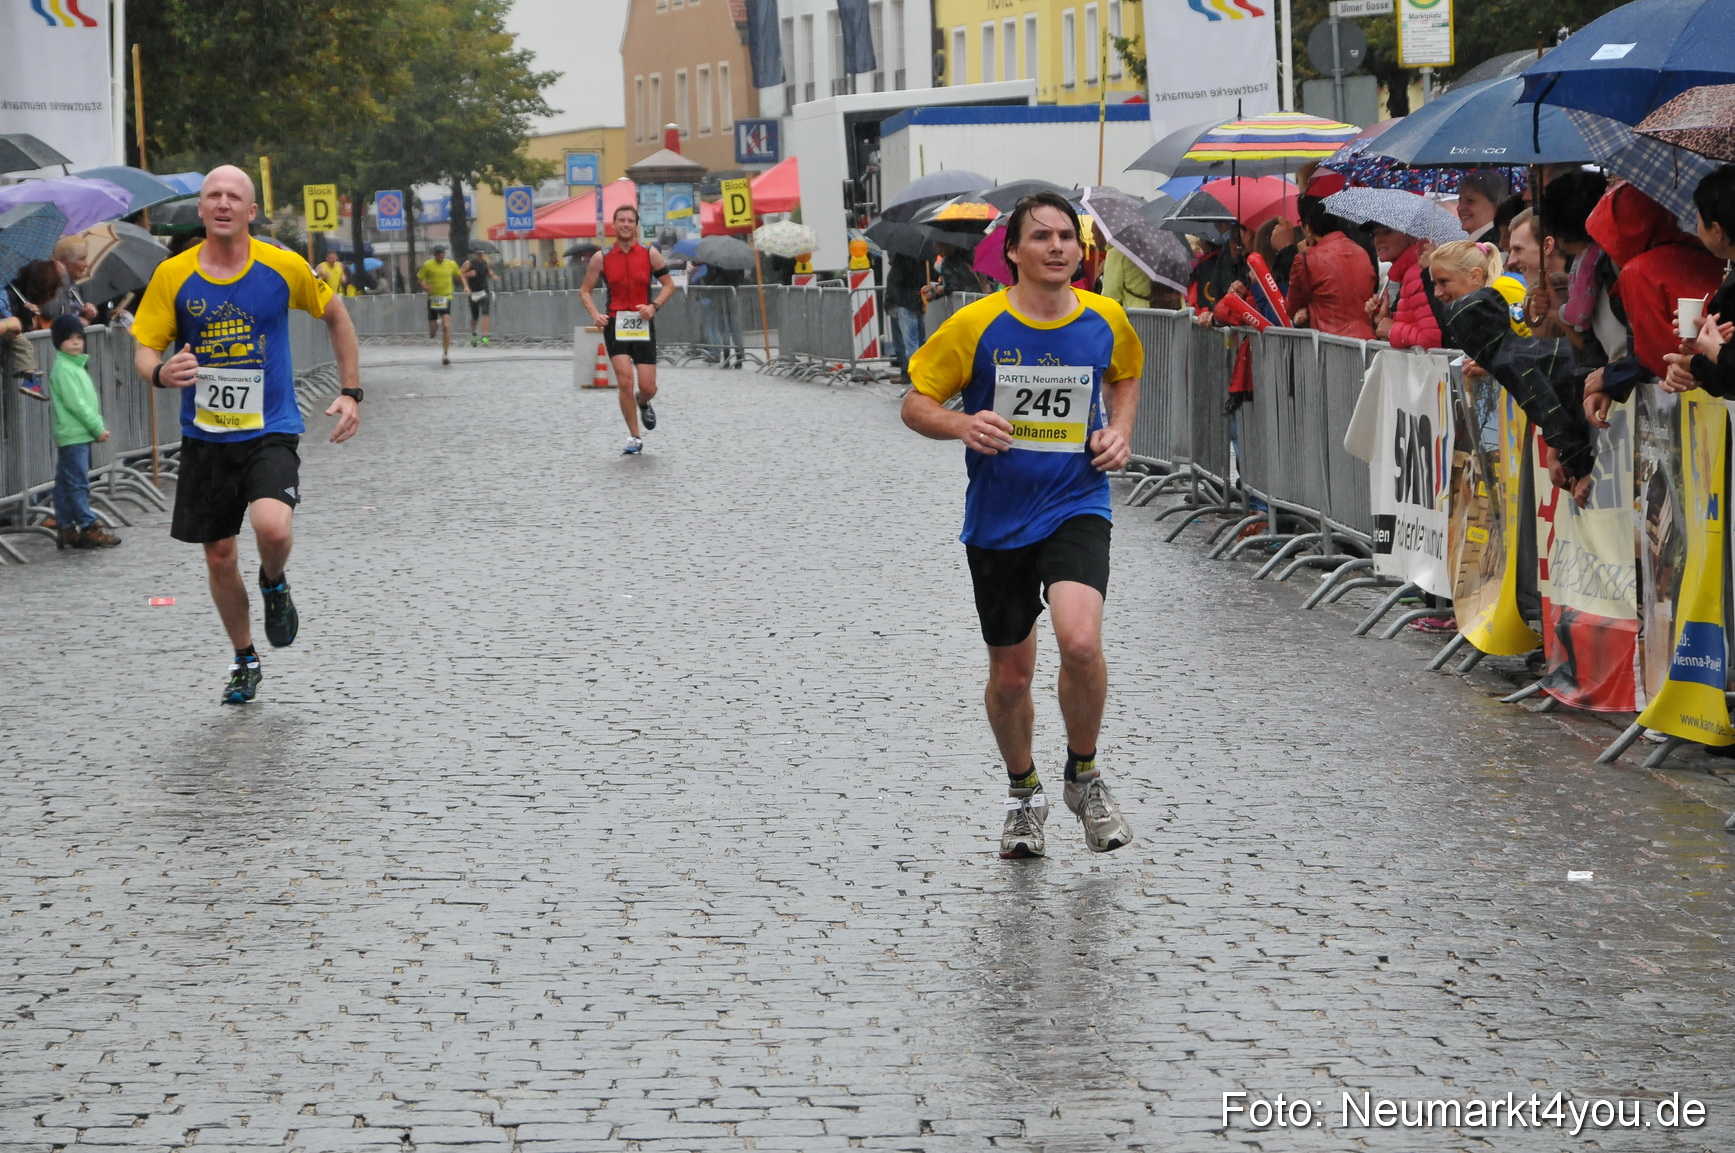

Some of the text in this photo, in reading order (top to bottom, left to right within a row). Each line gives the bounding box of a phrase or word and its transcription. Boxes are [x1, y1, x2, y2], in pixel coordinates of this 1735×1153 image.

[1341, 1, 1390, 13] Ulmer Gasse
[1408, 12, 1442, 20] Marktplatz
[307, 186, 332, 196] Block
[724, 181, 749, 190] Block
[313, 199, 329, 221] D
[730, 193, 746, 216] D
[380, 218, 401, 227] TAXI
[508, 216, 532, 227] TAXI
[622, 318, 643, 330] 232
[195, 373, 252, 383] PARTL Neumarkt
[998, 374, 1077, 384] PARTL Neumarkt
[208, 384, 250, 410] 267
[1012, 388, 1073, 418] 245
[215, 414, 240, 426] Silvio
[1009, 424, 1067, 439] Johannes
